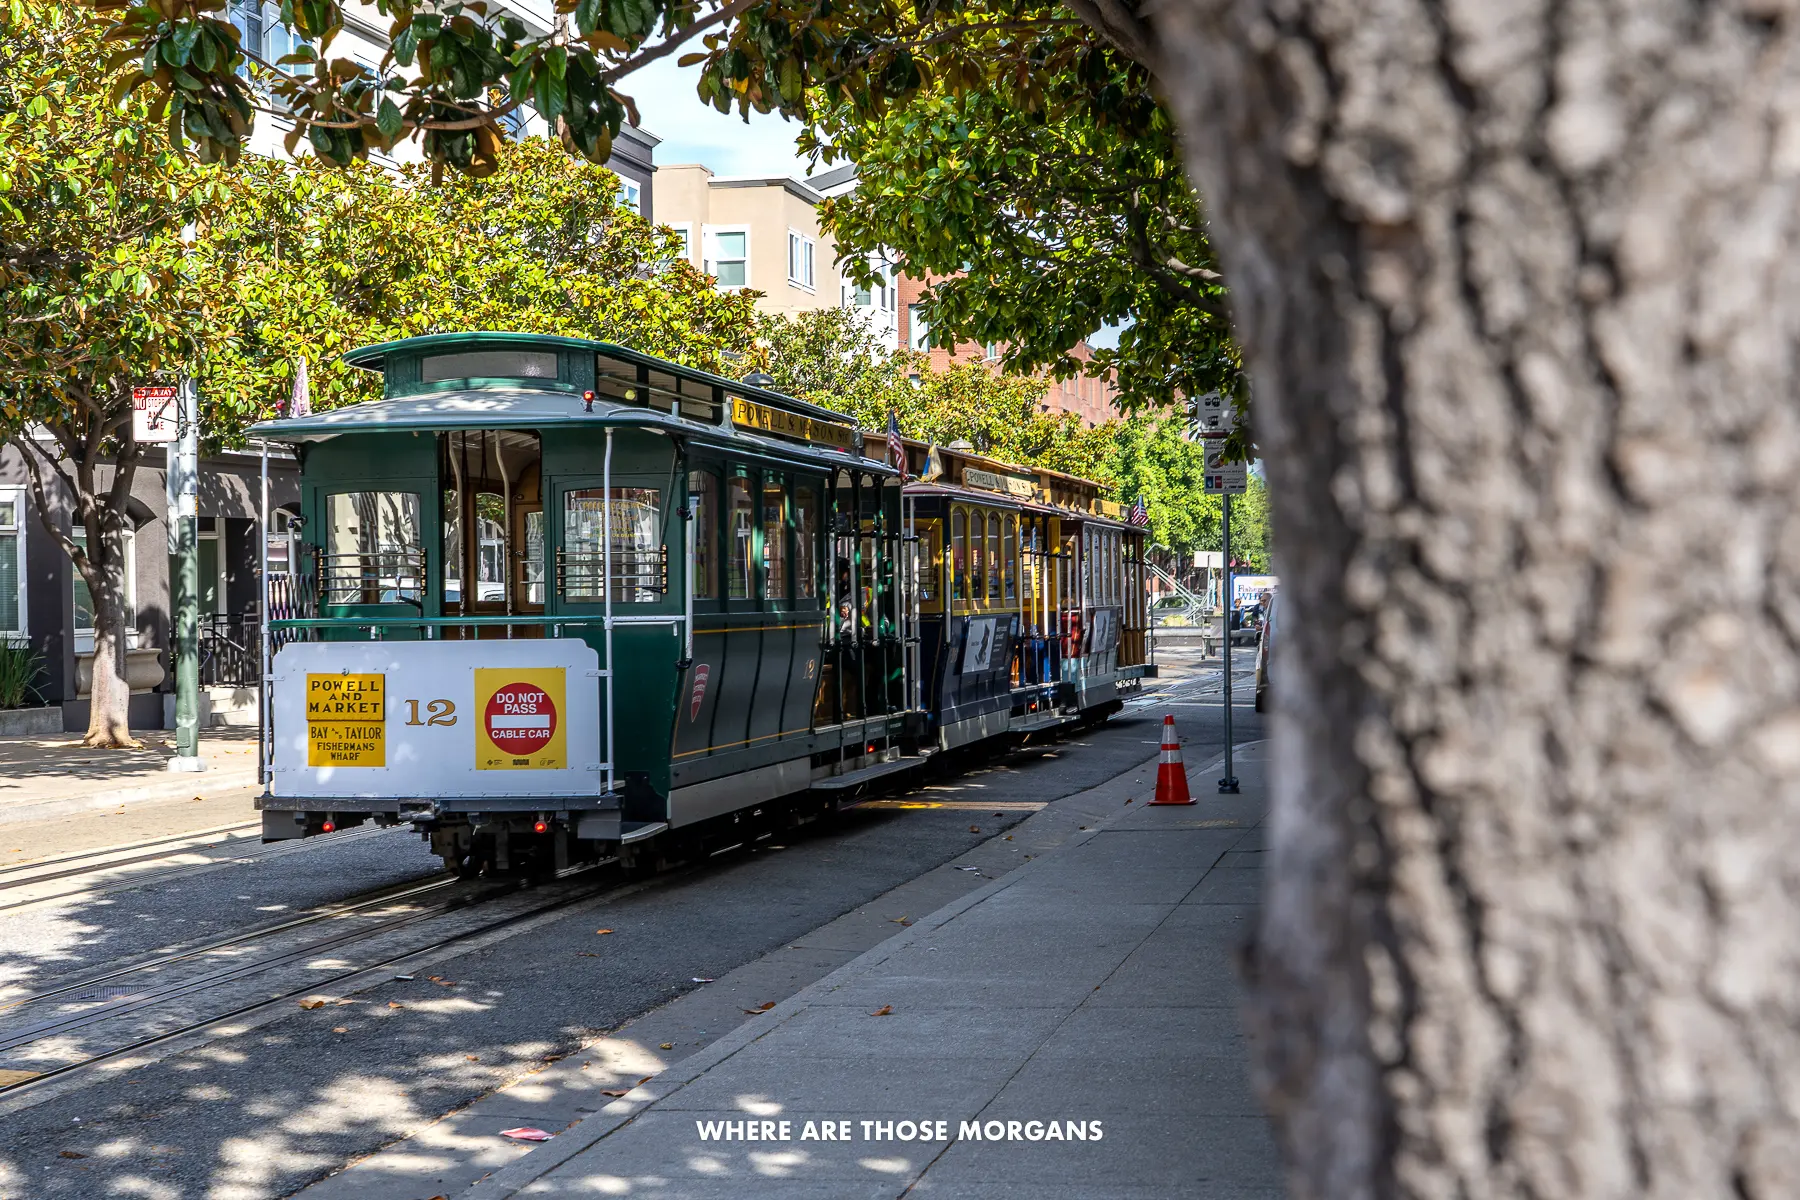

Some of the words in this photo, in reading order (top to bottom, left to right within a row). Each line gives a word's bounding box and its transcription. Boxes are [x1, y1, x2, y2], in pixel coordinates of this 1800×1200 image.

[134, 397, 146, 410] NO
[148, 398, 175, 407] STOPPNG
[737, 403, 785, 430] POWELL
[803, 659, 816, 680] 12
[311, 681, 379, 692] POWELL
[329, 693, 362, 701] AND
[496, 693, 515, 704] DO
[518, 693, 545, 703] NOT
[309, 702, 380, 713] MARKET
[405, 699, 457, 726] 12
[504, 703, 537, 714] PASS
[311, 727, 328, 739] BAY
[345, 727, 381, 739] TAYLOR
[492, 730, 526, 739] CABLE
[528, 729, 550, 738] CAR
[317, 742, 375, 751] FISHERMANS
[331, 752, 360, 761] WHARF
